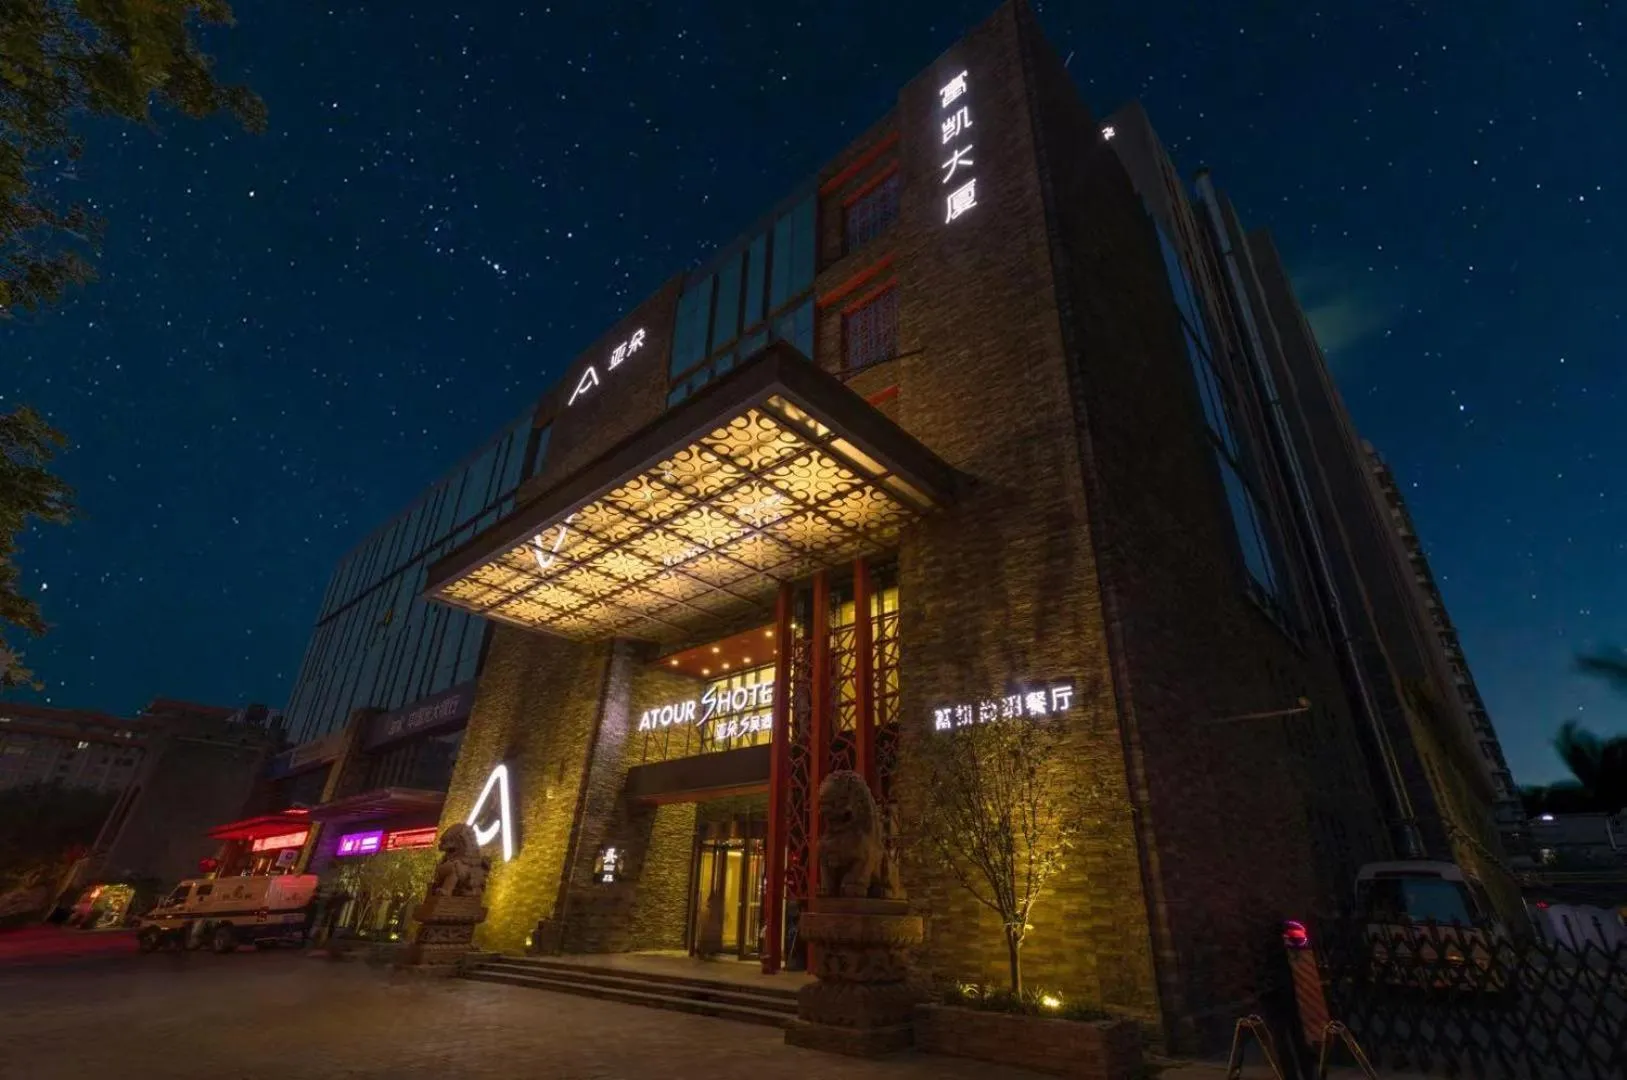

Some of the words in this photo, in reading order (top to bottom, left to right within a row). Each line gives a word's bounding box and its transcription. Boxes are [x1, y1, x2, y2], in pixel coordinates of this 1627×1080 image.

[939, 69, 978, 225] 富凯大厦
[607, 327, 646, 371] 亚朵
[638, 699, 697, 732] ATOUR
[696, 681, 774, 727] SHOTE
